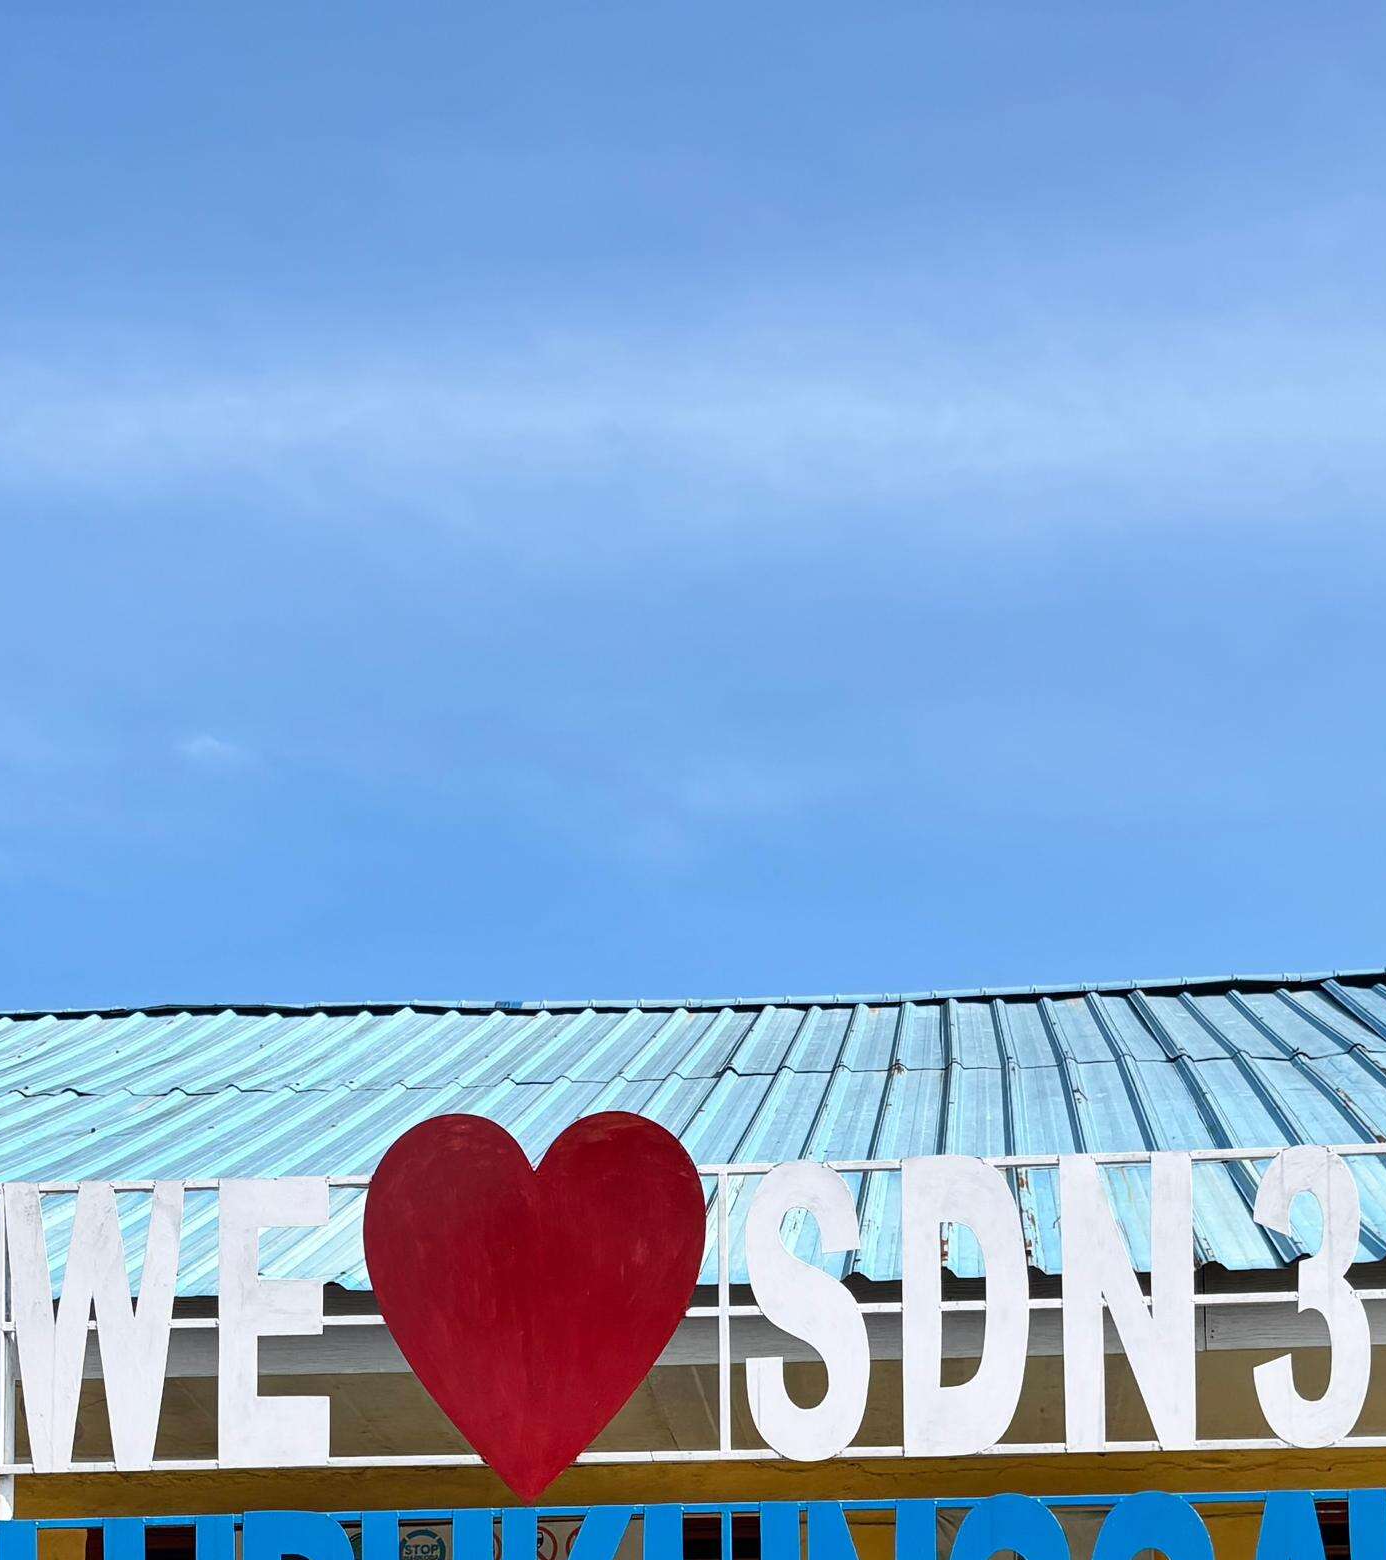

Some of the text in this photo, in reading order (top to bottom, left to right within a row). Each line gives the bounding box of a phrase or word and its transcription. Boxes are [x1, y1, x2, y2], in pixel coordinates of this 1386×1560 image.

[1, 1177, 331, 1474] WE
[746, 1153, 1198, 1462] SDN
[404, 1544, 439, 1555] STOP
